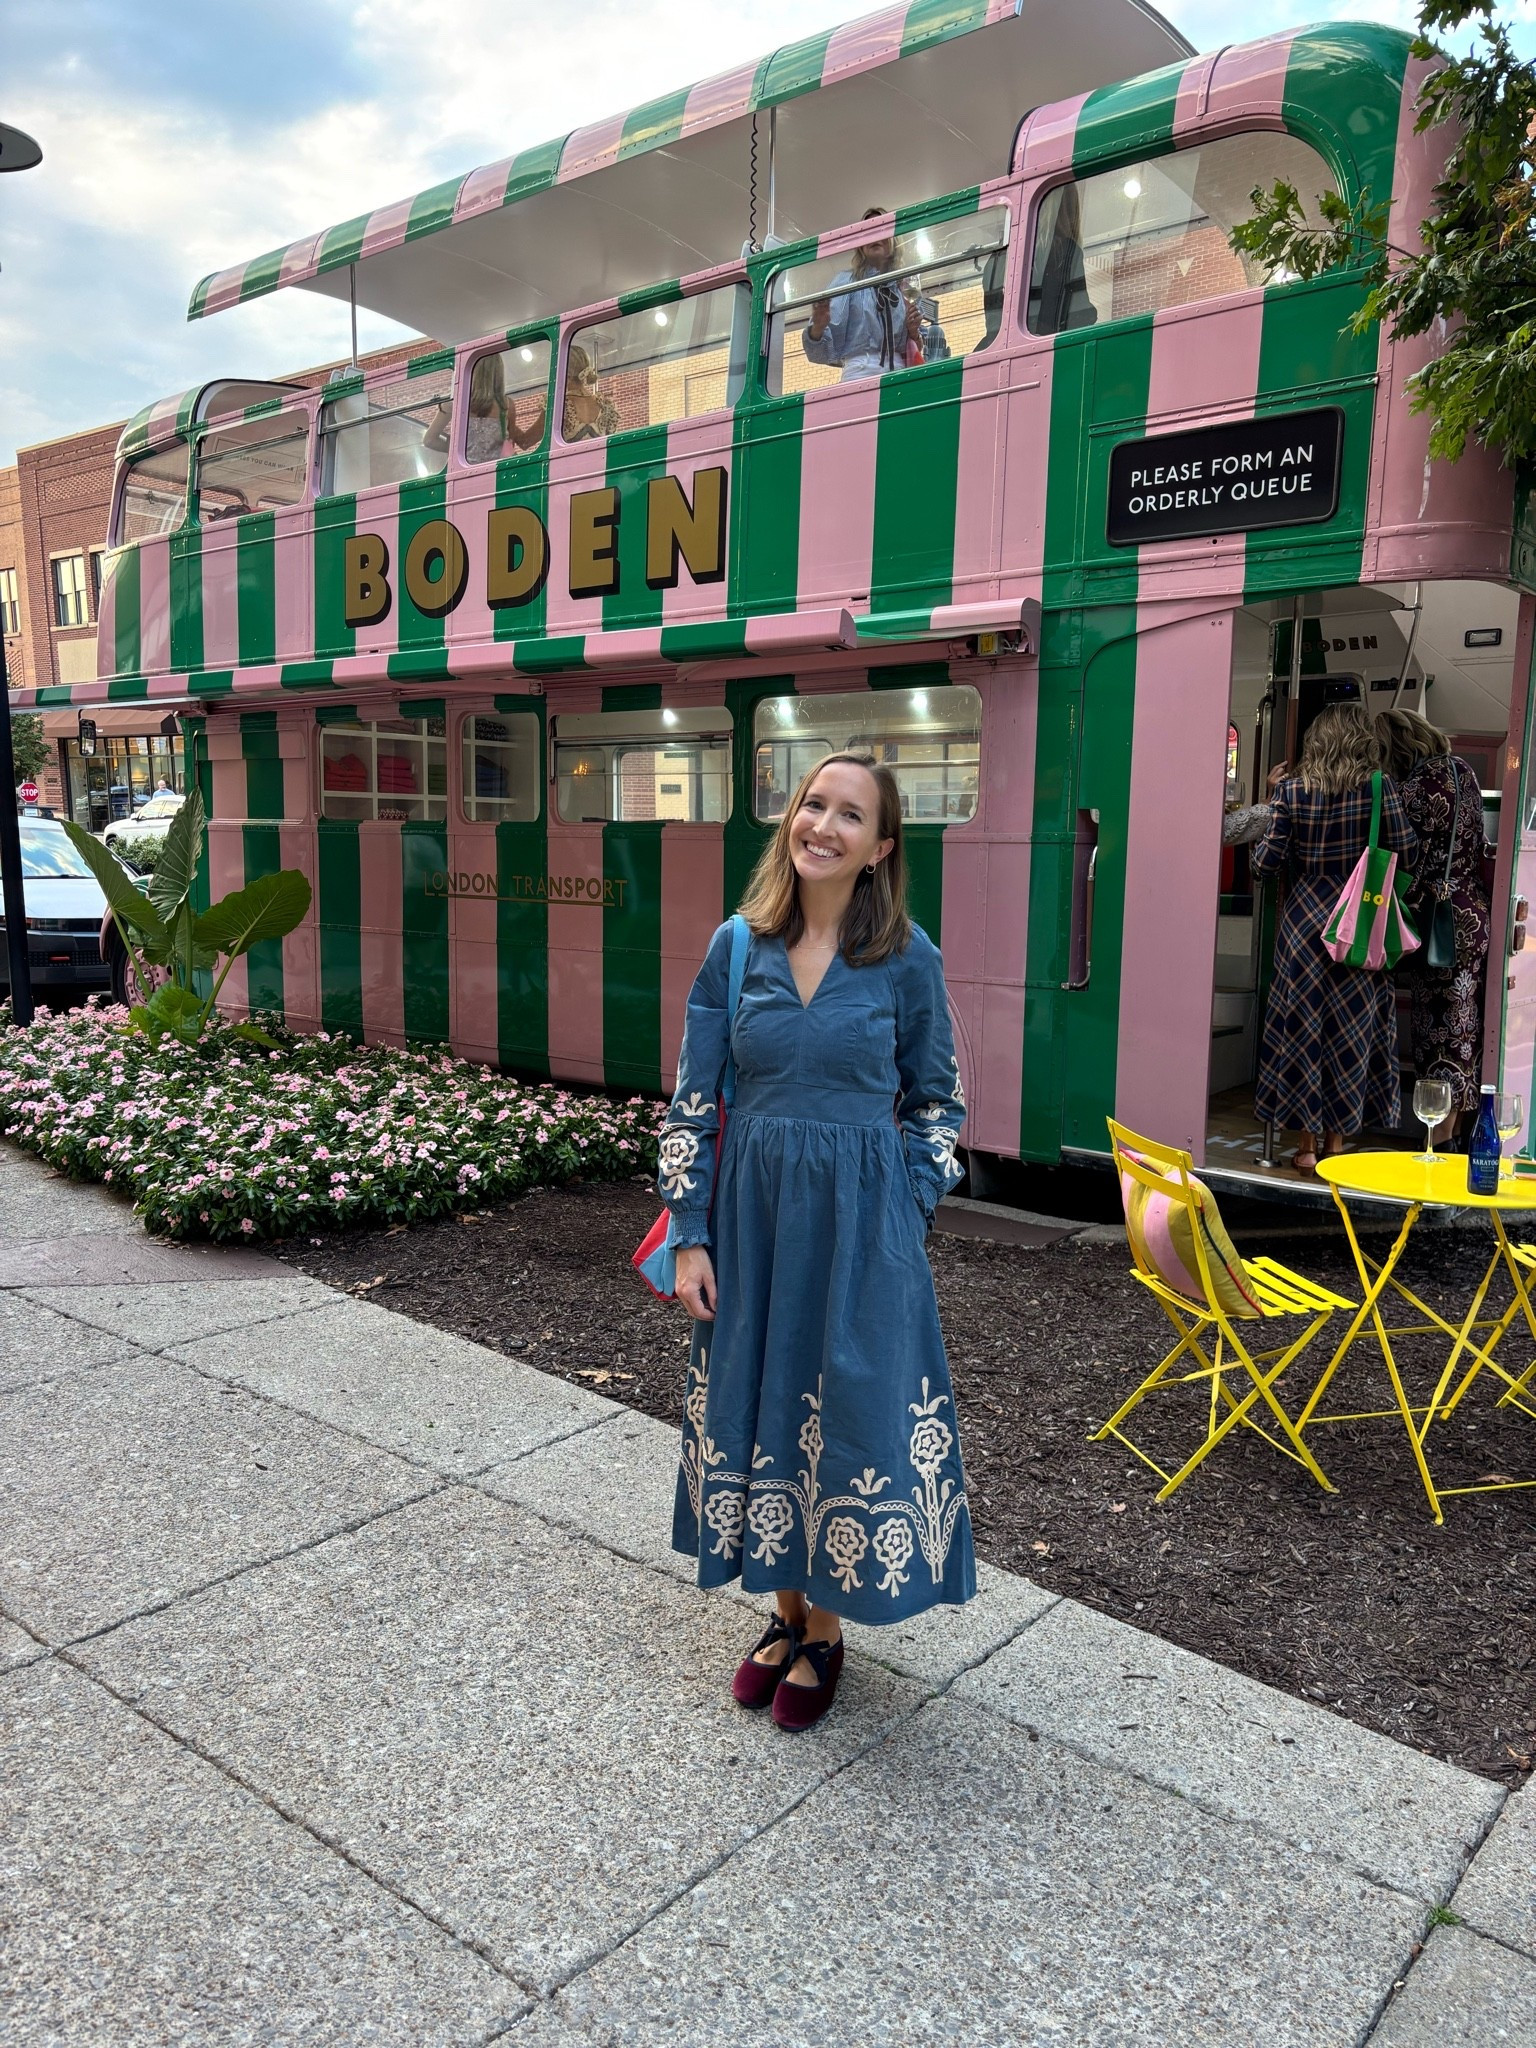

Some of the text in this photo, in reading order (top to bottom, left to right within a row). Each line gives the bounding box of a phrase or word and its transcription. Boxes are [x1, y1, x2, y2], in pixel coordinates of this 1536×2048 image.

[1131, 444, 1313, 488] PLEASE FORM AN
[1128, 473, 1313, 514] ORDERLY QUEUE
[345, 466, 729, 628] BODEN
[1302, 635, 1378, 653] BODEN
[21, 788, 38, 797] STOP
[424, 870, 628, 908] LONDON TRANSPORT
[1472, 1158, 1499, 1166] SARATOG
